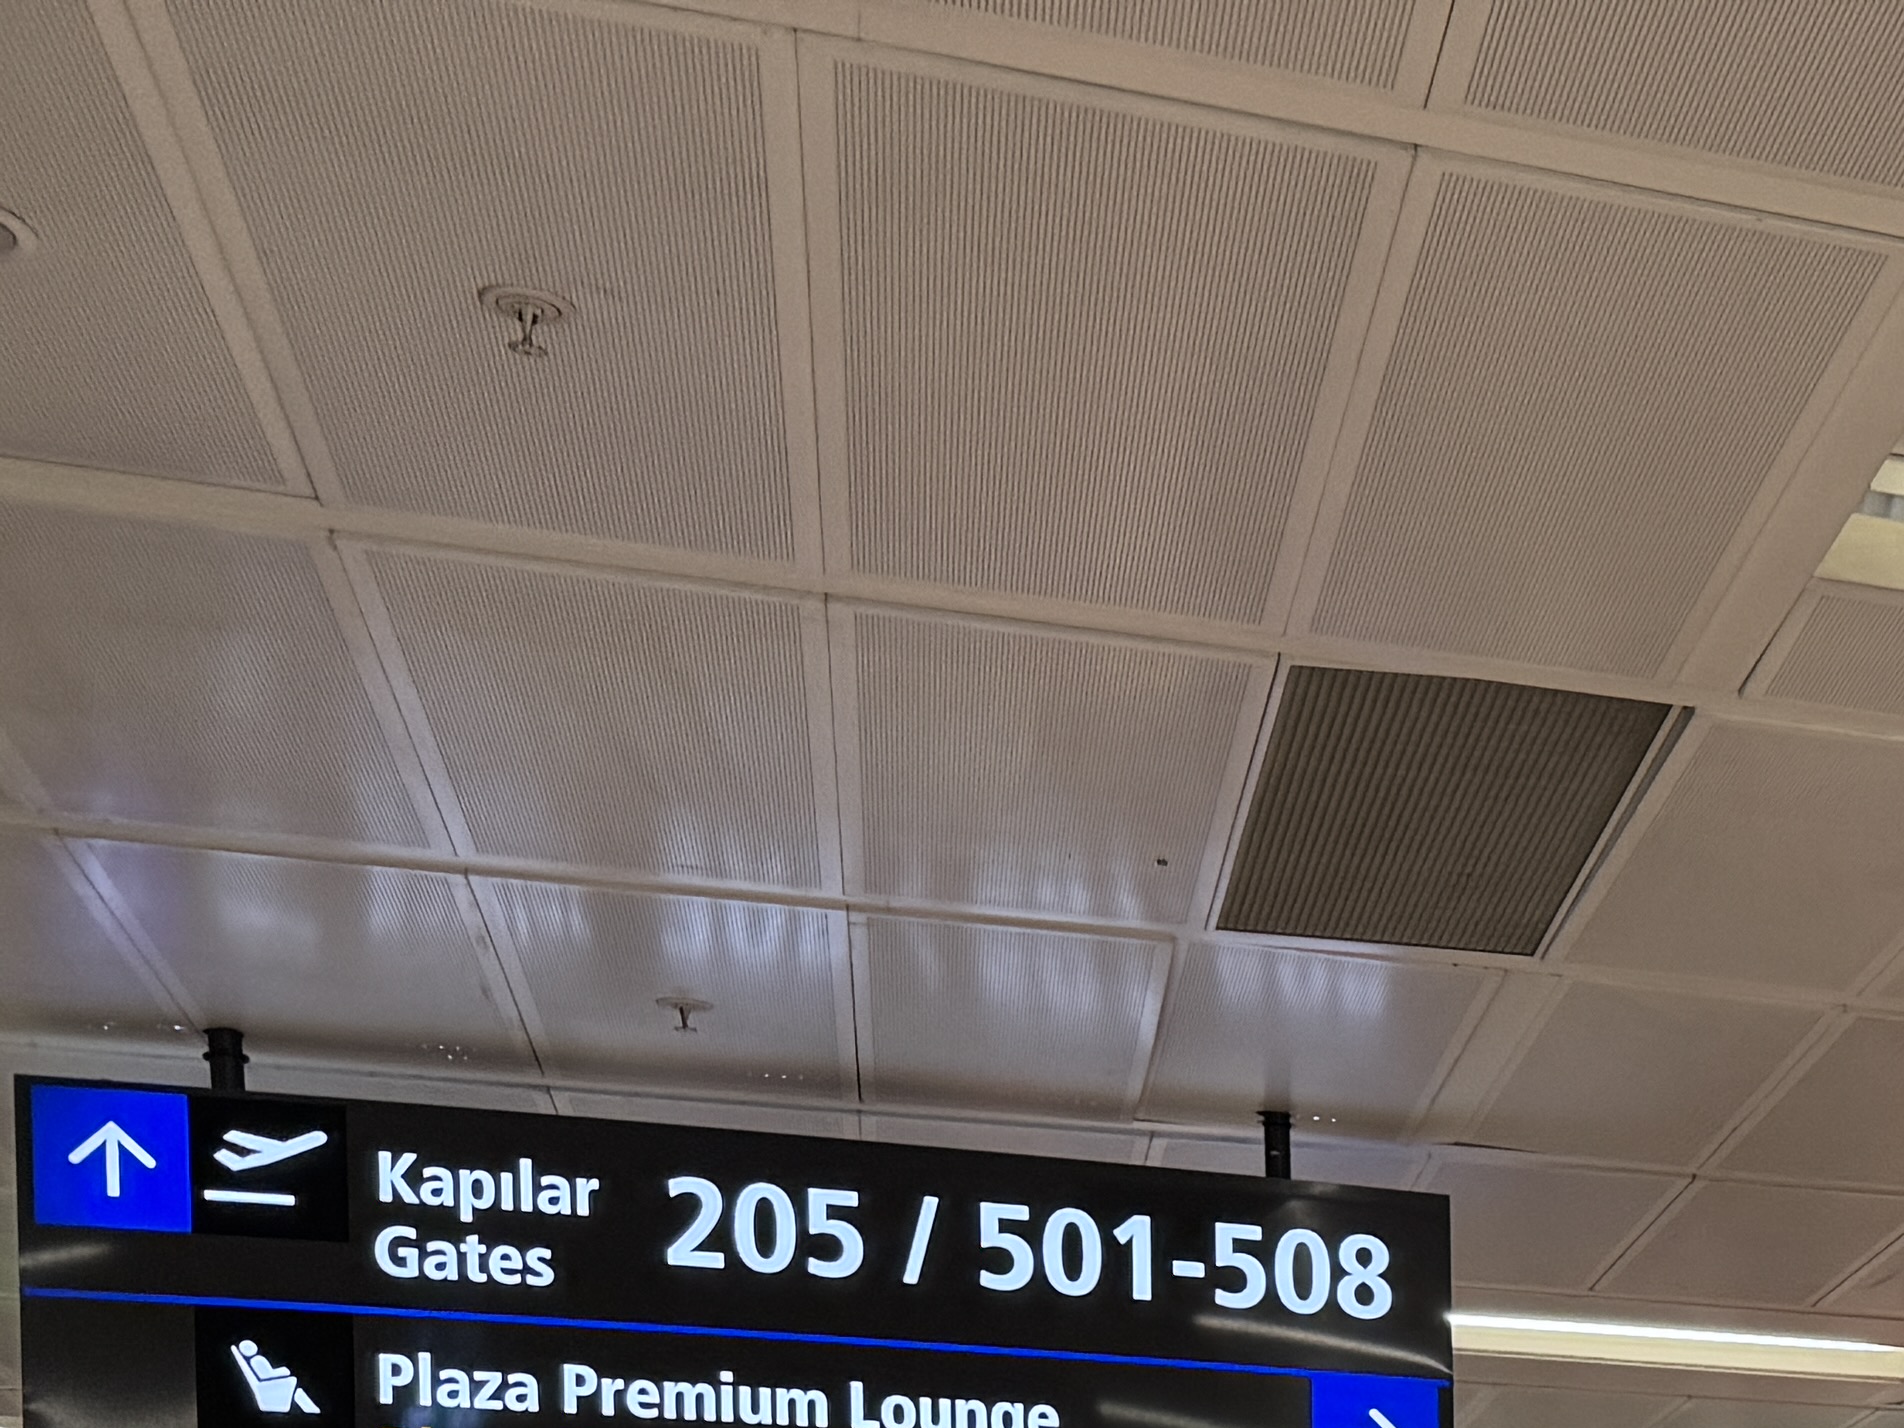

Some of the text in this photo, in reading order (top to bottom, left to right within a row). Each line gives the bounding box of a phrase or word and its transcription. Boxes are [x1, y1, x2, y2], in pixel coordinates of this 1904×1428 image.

[376, 1150, 601, 1225] Kapılar
[373, 1225, 556, 1288] Gates
[665, 1176, 1395, 1321] 205 / 501-508
[377, 1352, 540, 1414] Plaza
[561, 1362, 829, 1428] Premium
